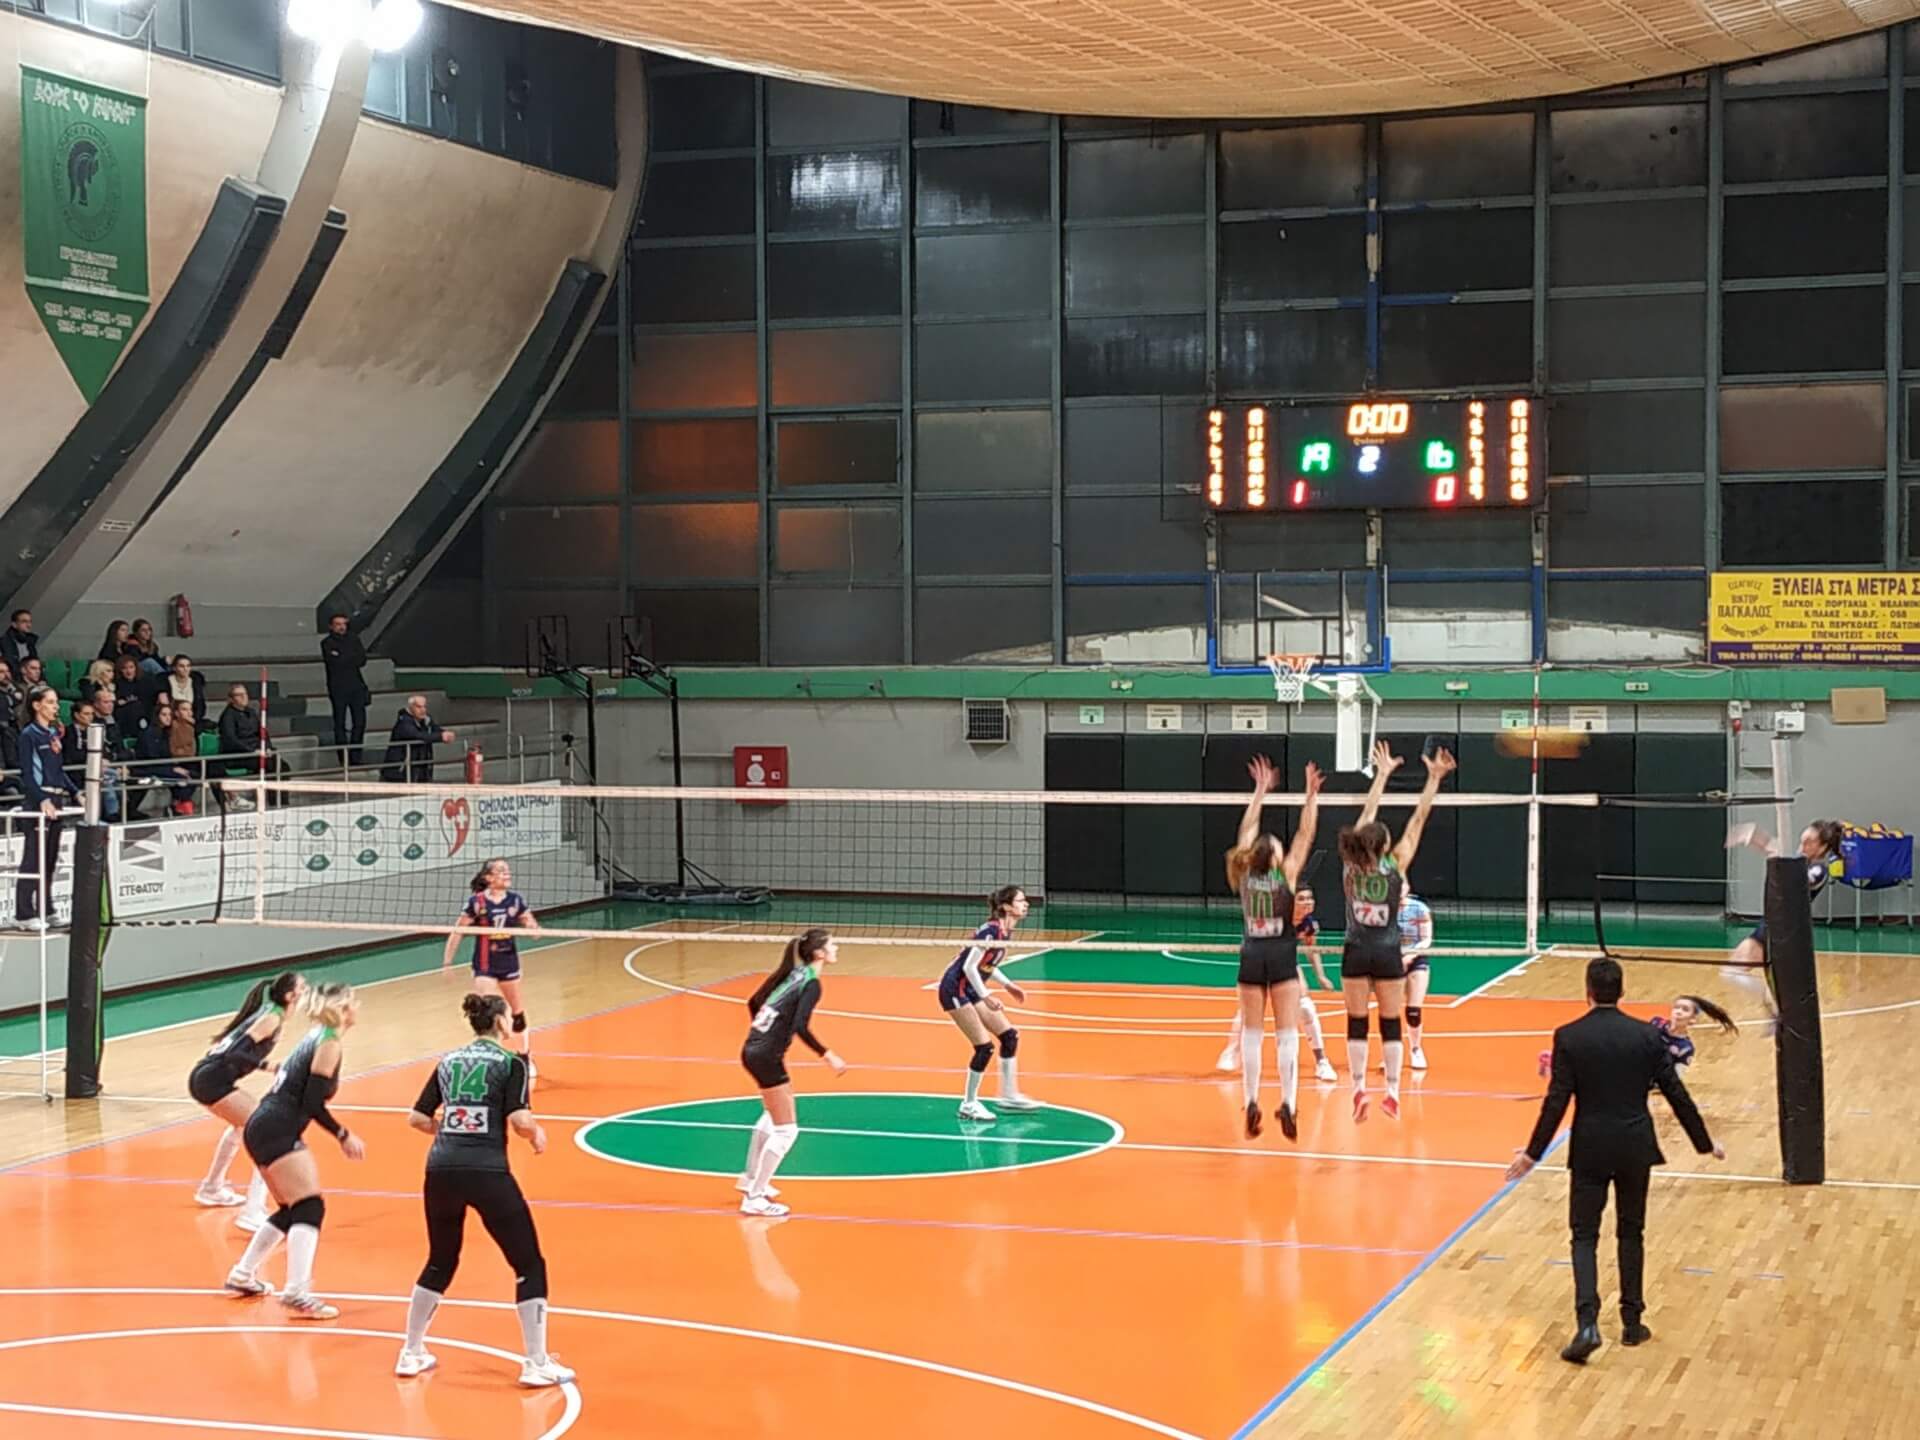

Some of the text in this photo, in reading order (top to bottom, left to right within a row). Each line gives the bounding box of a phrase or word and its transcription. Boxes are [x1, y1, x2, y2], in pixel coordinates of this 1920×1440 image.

[1347, 403, 1409, 434] 0:00
[1358, 446, 1380, 472] 2
[1293, 479, 1305, 504] 1
[1436, 477, 1455, 502] 0
[1773, 578, 1824, 595] ΞΥΛΕΙΑ
[1829, 579, 1851, 595] ΣΤΑ
[1857, 578, 1907, 595] ΜΕΤΡΑ
[1718, 605, 1772, 618] ΠΑΓΚΑΛΟΣ
[449, 1060, 488, 1102] 14
